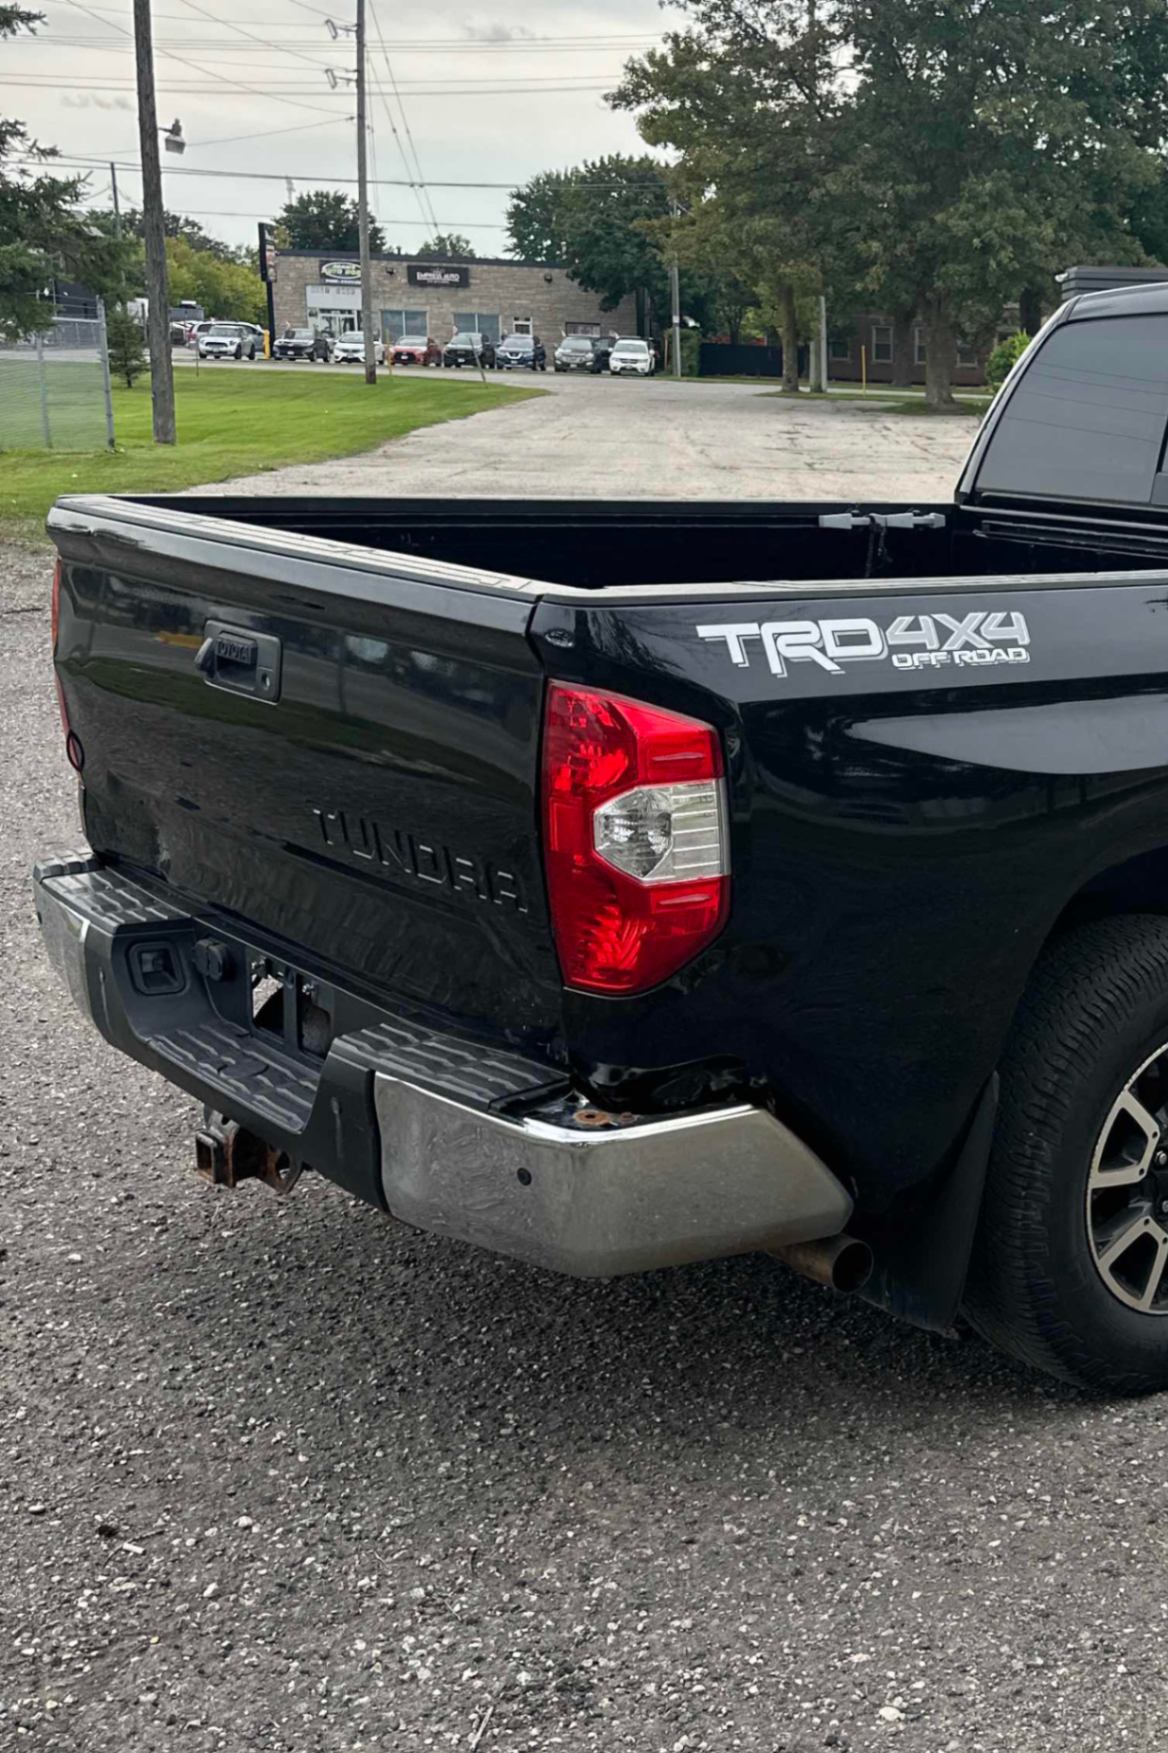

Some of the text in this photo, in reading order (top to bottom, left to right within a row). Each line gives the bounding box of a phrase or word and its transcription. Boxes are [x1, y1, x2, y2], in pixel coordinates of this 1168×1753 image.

[695, 611, 1031, 678] TRD 4X4
[891, 647, 1031, 670] OFF ROAD
[312, 807, 529, 913] TUNDRA
